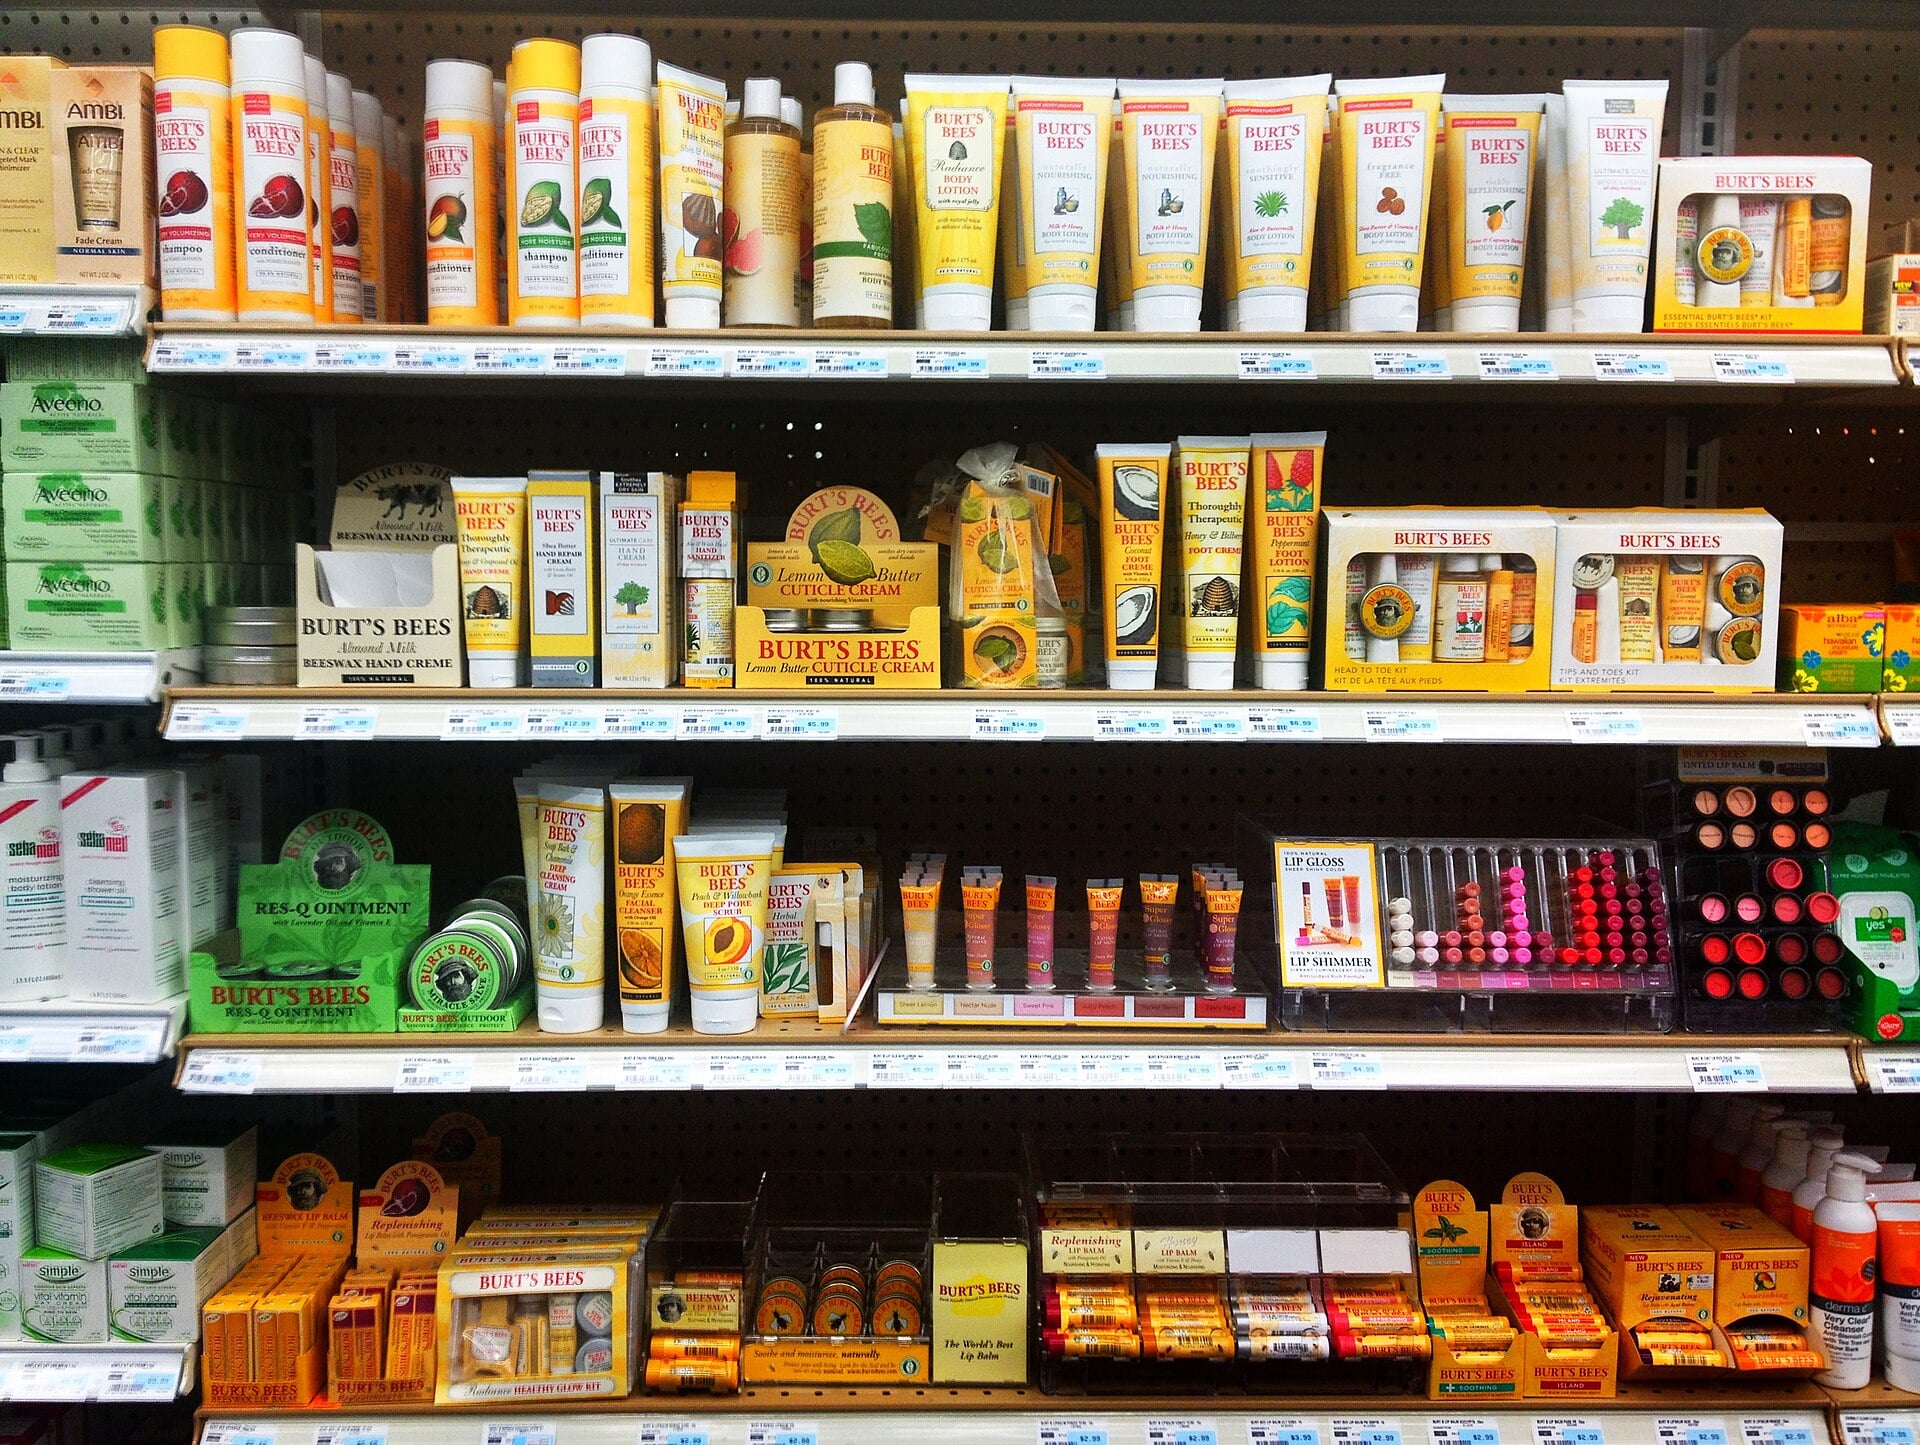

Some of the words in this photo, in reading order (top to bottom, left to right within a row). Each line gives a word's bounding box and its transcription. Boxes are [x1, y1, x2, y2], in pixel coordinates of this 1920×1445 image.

[934, 112, 983, 124] BURT'S
[942, 126, 976, 138] BEES
[1037, 122, 1092, 137] BURT'S
[1245, 123, 1300, 139] BURT'S
[1363, 120, 1420, 135] BURT'S
[1596, 127, 1647, 140] BURT'S
[519, 132, 569, 148] BURT'S
[1046, 137, 1085, 150] BEES
[1253, 138, 1293, 152] BEES
[1371, 135, 1412, 149] BEES
[1604, 142, 1641, 153] BEES
[525, 147, 563, 161] BEES
[931, 159, 985, 173] Radiance
[1366, 162, 1415, 172] fragrance
[943, 175, 973, 184] BODY
[1037, 172, 1092, 180] NOURISHING
[1249, 173, 1293, 182] SENSITIVE
[1379, 170, 1401, 179] FREE
[1715, 175, 1771, 189] BURT'S
[1775, 175, 1814, 188] BEES
[937, 185, 979, 195] LOTION
[1041, 231, 1061, 239] BODY
[1062, 231, 1089, 239] LOTION
[75, 237, 94, 245] Fade
[96, 237, 123, 245] Cream
[538, 237, 571, 247] MOISTURE
[249, 247, 306, 259] conditioner
[524, 252, 568, 262] shampoo
[1740, 321, 1765, 329] BURT'S
[31, 397, 102, 413] Aveeno
[457, 502, 516, 516] BURT'S
[536, 509, 582, 520] BURT'S
[466, 517, 505, 530] BEES
[685, 515, 729, 527] BURT'S
[1266, 516, 1314, 527] BURT'S
[543, 522, 575, 533] BEES
[692, 527, 722, 539] BEES
[1114, 523, 1160, 535] BURT'S
[1273, 527, 1306, 538] BEES
[461, 534, 511, 545] Thoroughly
[1121, 534, 1152, 545] BEES
[1270, 539, 1310, 548] Peppermint
[1394, 533, 1448, 546] BURT'S
[1452, 533, 1490, 545] BEES
[1620, 534, 1675, 548] BURT'S
[1680, 535, 1720, 548] BEES
[461, 544, 512, 555] Therapeutic
[1275, 550, 1303, 558] FOOT
[687, 553, 726, 561] SANITIZER
[1269, 558, 1310, 567] LOTION
[1122, 563, 1153, 571] CREME
[780, 584, 852, 596] CUTICLE
[856, 584, 901, 596] CREAM
[1827, 614, 1858, 623] alba
[301, 619, 385, 636] BURT'S
[393, 619, 450, 636] BEES
[337, 642, 383, 654] Almond
[386, 641, 417, 654] Milk
[758, 641, 850, 660] BURT'S
[857, 641, 918, 660] BEES
[303, 659, 362, 669] BEESWAX
[365, 659, 403, 668] HAND
[406, 659, 452, 668] CREME
[745, 662, 777, 674] Lemon
[780, 662, 809, 675] Butter
[812, 662, 879, 673] CUTICLE
[881, 662, 935, 673] CREAM
[1732, 762, 1755, 770] BALM
[1284, 857, 1304, 867] LIP
[1306, 857, 1344, 867] GLOSS
[618, 867, 665, 878] BURT'S
[700, 864, 755, 878] BURT'S
[624, 878, 656, 889] BEES
[708, 878, 746, 890] BEES
[728, 900, 752, 908] PORE
[767, 896, 802, 909] BEES
[255, 902, 310, 917] RES-Q
[314, 902, 411, 915] OINTMENT
[618, 907, 663, 915] CLEANSER
[713, 908, 742, 916] SCRUB
[772, 912, 797, 921] Herbal
[765, 920, 804, 929] BLEMISH
[1865, 919, 1885, 931] yes
[772, 929, 798, 937] STICK
[1290, 957, 1309, 967] LIP
[1312, 957, 1372, 968] SHIMMER
[211, 986, 300, 1005] BURT'S
[307, 986, 370, 1004] BEES
[225, 1007, 271, 1020] RES-Q
[273, 1007, 356, 1017] OINTMENT
[1512, 1184, 1552, 1195] BURT'S
[1519, 1195, 1547, 1205] BEES
[262, 1213, 304, 1221] BEESWAX
[306, 1213, 320, 1221] LIP
[321, 1213, 348, 1221] BALM
[371, 1221, 443, 1232] Replenishing
[1051, 1236, 1122, 1247] Replenishing
[1636, 1262, 1674, 1272] BURT'S
[1677, 1261, 1703, 1271] BEES
[1731, 1260, 1770, 1271] BURT'S
[1772, 1260, 1798, 1270] BEES
[40, 1265, 79, 1278] simple
[480, 1273, 539, 1290] BURT'S
[543, 1272, 584, 1286] BEES
[939, 1283, 984, 1297] BURT'S
[988, 1282, 1020, 1295] BEES
[685, 1294, 736, 1303] BEESWAX
[1641, 1293, 1697, 1303] Rejuvenating
[1824, 1303, 1859, 1312] derma
[1824, 1313, 1842, 1323] Very
[1845, 1314, 1867, 1324] Clear
[1823, 1322, 1865, 1333] Cleanser
[944, 1340, 960, 1350] The
[962, 1340, 994, 1350] World's
[996, 1340, 1013, 1349] Best
[960, 1352, 976, 1361] Lip
[978, 1351, 999, 1360] Balm
[1440, 1370, 1482, 1380] BURT'S
[1485, 1369, 1514, 1379] BEES
[210, 1385, 259, 1396] BURT'S
[263, 1385, 297, 1396] BEES
[463, 1384, 512, 1396] Radiance
[514, 1384, 555, 1395] HEALTHY
[556, 1383, 583, 1394] GLOW
[585, 1382, 601, 1392] KIT
